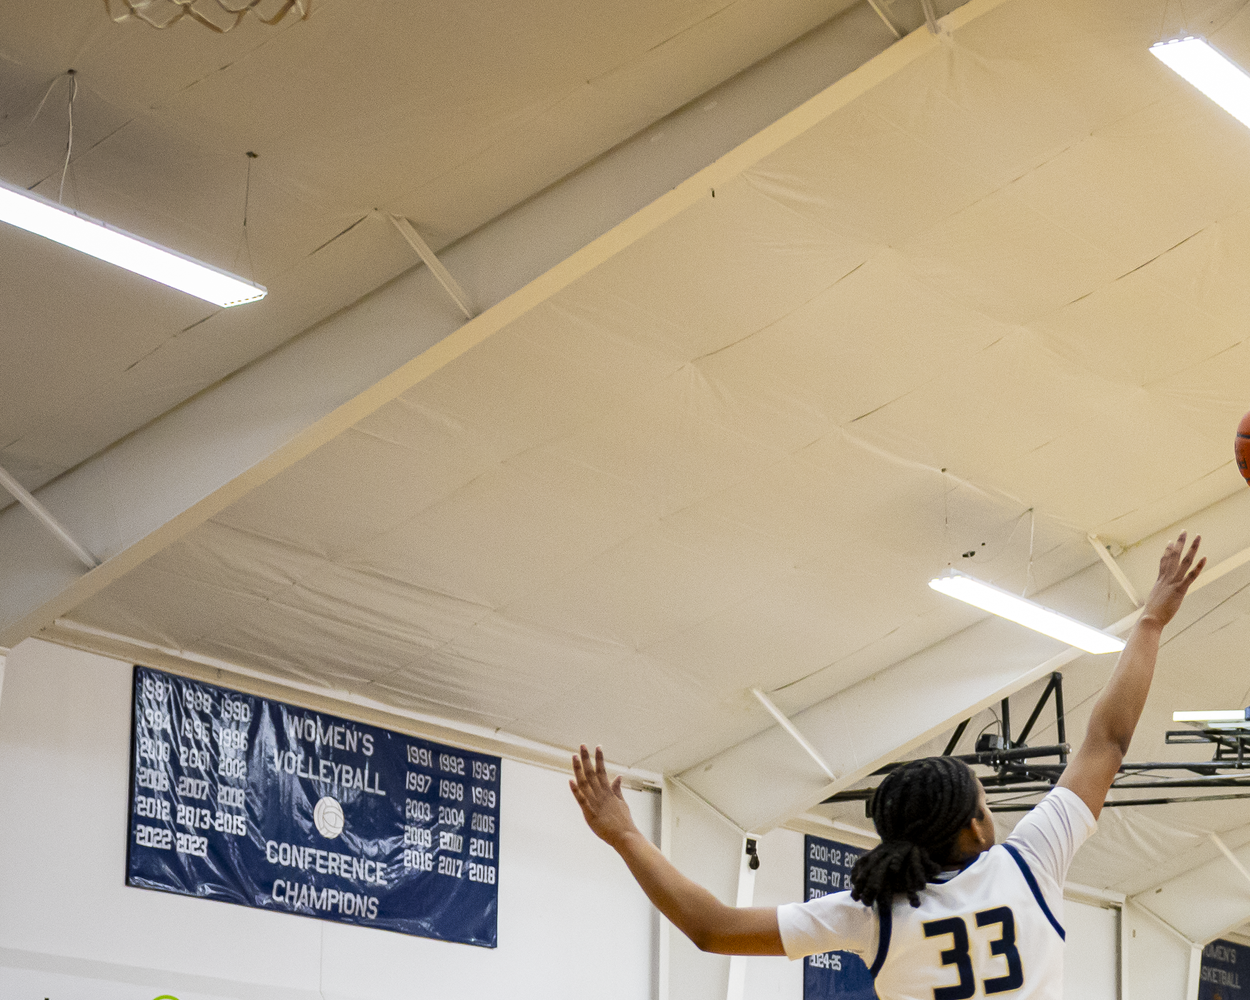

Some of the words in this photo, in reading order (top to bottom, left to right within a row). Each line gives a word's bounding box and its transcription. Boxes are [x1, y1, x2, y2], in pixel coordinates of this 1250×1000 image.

[288, 714, 375, 756] WOMEN'S
[273, 749, 386, 796] VOLLEYBALL
[407, 745, 432, 768] 1991
[439, 753, 465, 776] 1992
[472, 760, 497, 782] 1993
[406, 771, 432, 793] 1997
[439, 779, 464, 801] 1998
[472, 786, 497, 808] 1999
[177, 804, 211, 830] 2013
[215, 811, 247, 836] 2015
[405, 798, 431, 821] 2003
[438, 806, 465, 827] 2004
[136, 825, 172, 850] 2022
[176, 832, 208, 857] 2023
[404, 826, 432, 848] 2009
[470, 838, 494, 859] 2011
[809, 843, 841, 866] 2001-02
[266, 840, 388, 885] CONFERENCE
[404, 849, 433, 871] 2016
[438, 855, 463, 878] 2017
[469, 863, 496, 885] 2018
[272, 879, 379, 919] CHAMPIONS
[1200, 966, 1241, 989] SKETBALL
